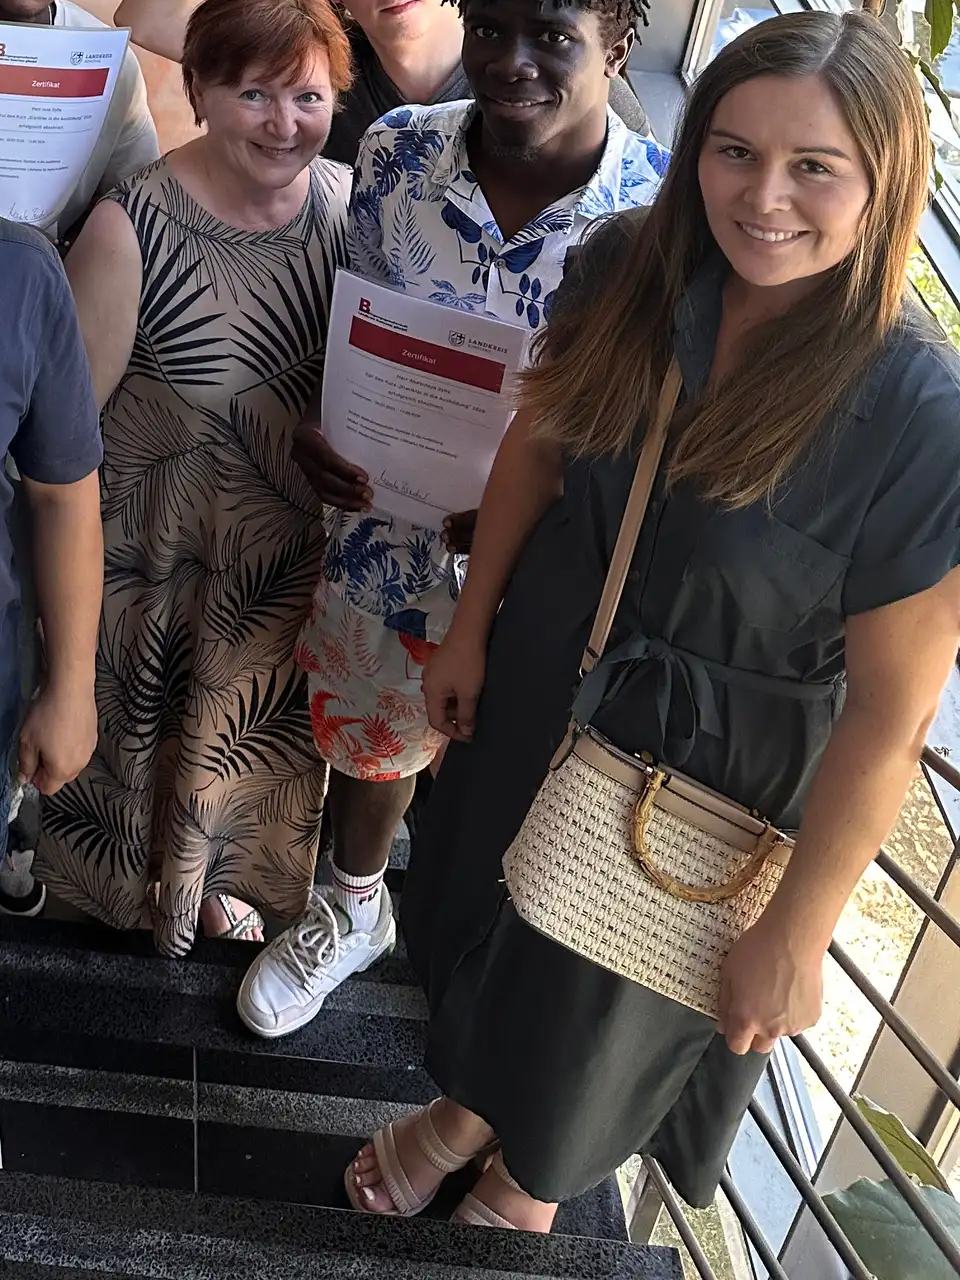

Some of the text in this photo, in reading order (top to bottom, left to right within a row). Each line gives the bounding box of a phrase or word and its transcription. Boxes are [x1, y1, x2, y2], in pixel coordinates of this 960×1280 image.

[32, 80, 60, 88] Zertifikat
[468, 339, 508, 354] LANDKREIS
[402, 349, 436, 365] Zertifikat
